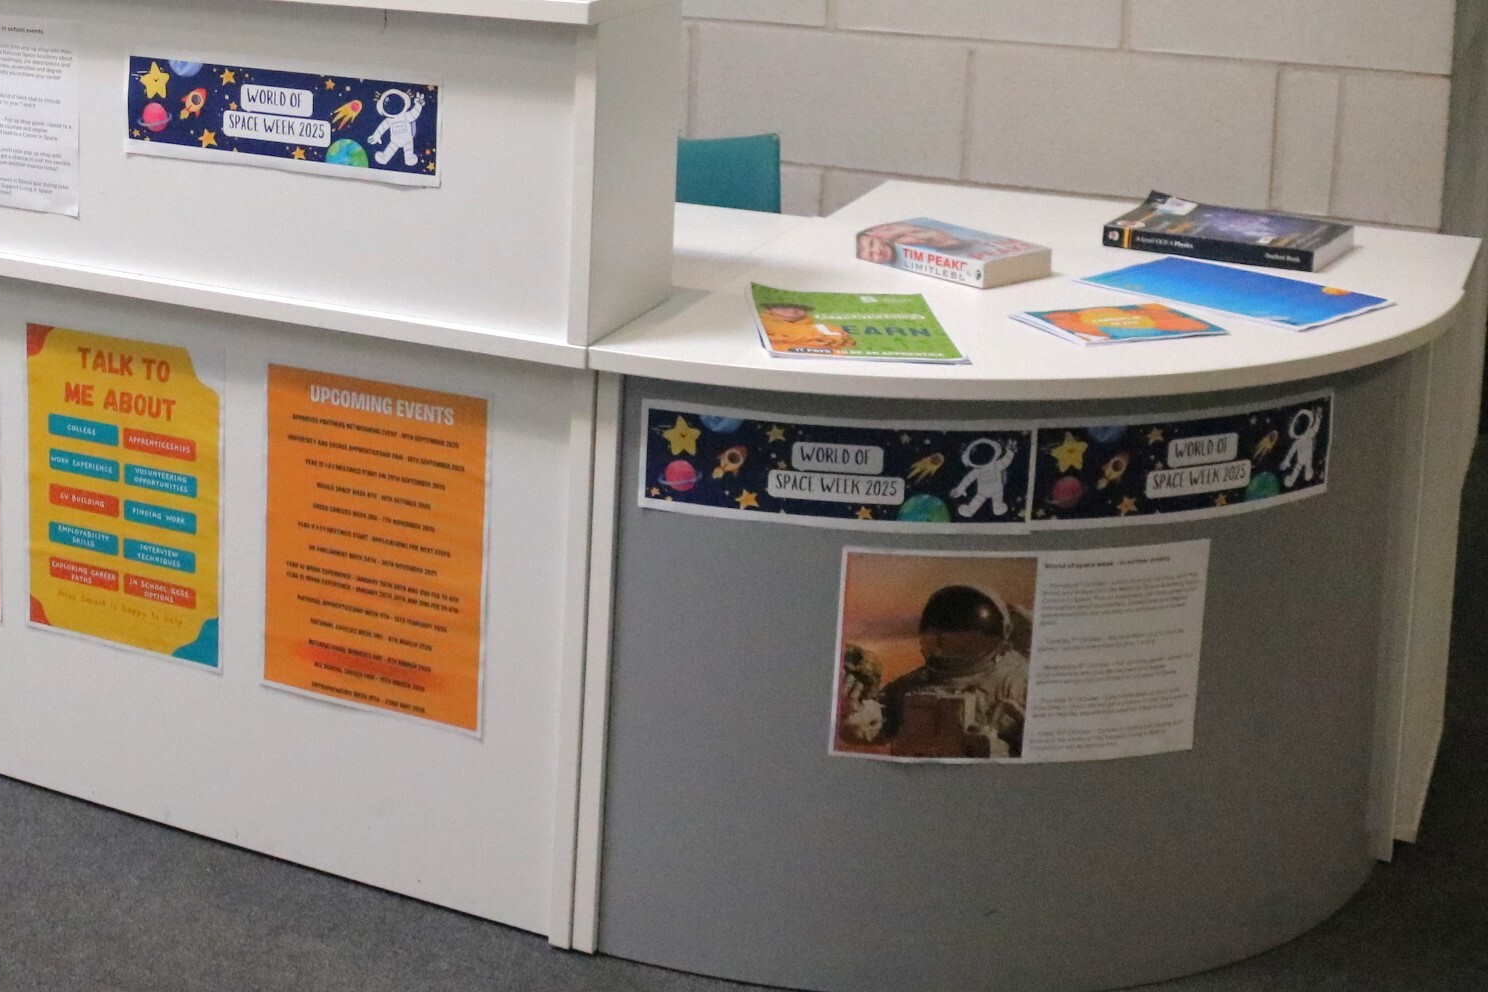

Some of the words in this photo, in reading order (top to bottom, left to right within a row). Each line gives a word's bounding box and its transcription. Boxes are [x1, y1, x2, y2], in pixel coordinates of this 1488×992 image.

[247, 88, 286, 106] WORLD
[290, 93, 301, 107] OF
[229, 114, 259, 131] SPACE
[264, 118, 295, 135] WEEK
[299, 122, 324, 138] 2025
[903, 248, 923, 261] TIM
[78, 347, 133, 376] TALK
[142, 358, 170, 383] TO
[65, 382, 94, 406] ME
[103, 389, 176, 421] ABOUT
[310, 385, 393, 415] UPCOMING
[397, 400, 454, 425] EVENTS
[67, 424, 96, 435] COLLEGE
[129, 435, 190, 454] APPRENTICESHIPS
[1175, 439, 1212, 458] WORLD
[1217, 437, 1227, 454] OF
[801, 446, 850, 464] WORLD
[855, 449, 869, 465] OF
[51, 456, 69, 464] WORK
[73, 459, 112, 473] EXPERIENCE
[135, 467, 187, 483] VOLUNTEERING
[1153, 471, 1183, 489] SPACE
[1190, 469, 1219, 485] WEEK
[1223, 464, 1247, 482] 2025
[134, 477, 188, 493] OPPORTUNITIES
[776, 474, 814, 491] SPACE
[821, 478, 860, 494] WEEK
[866, 480, 898, 496] 2025
[133, 508, 161, 520] FINDING
[166, 516, 185, 524] WORK
[58, 525, 109, 542] EMPLOYABILITY
[72, 537, 94, 547] SKILLS
[140, 544, 178, 557] INTERVIEW
[137, 553, 180, 568] TECHNIQUES
[52, 561, 87, 574] EXPLORING
[91, 569, 115, 581] CAREER
[71, 575, 92, 584] PATHS
[141, 580, 167, 593] SCHOOL
[145, 591, 173, 603] OPTIONS
